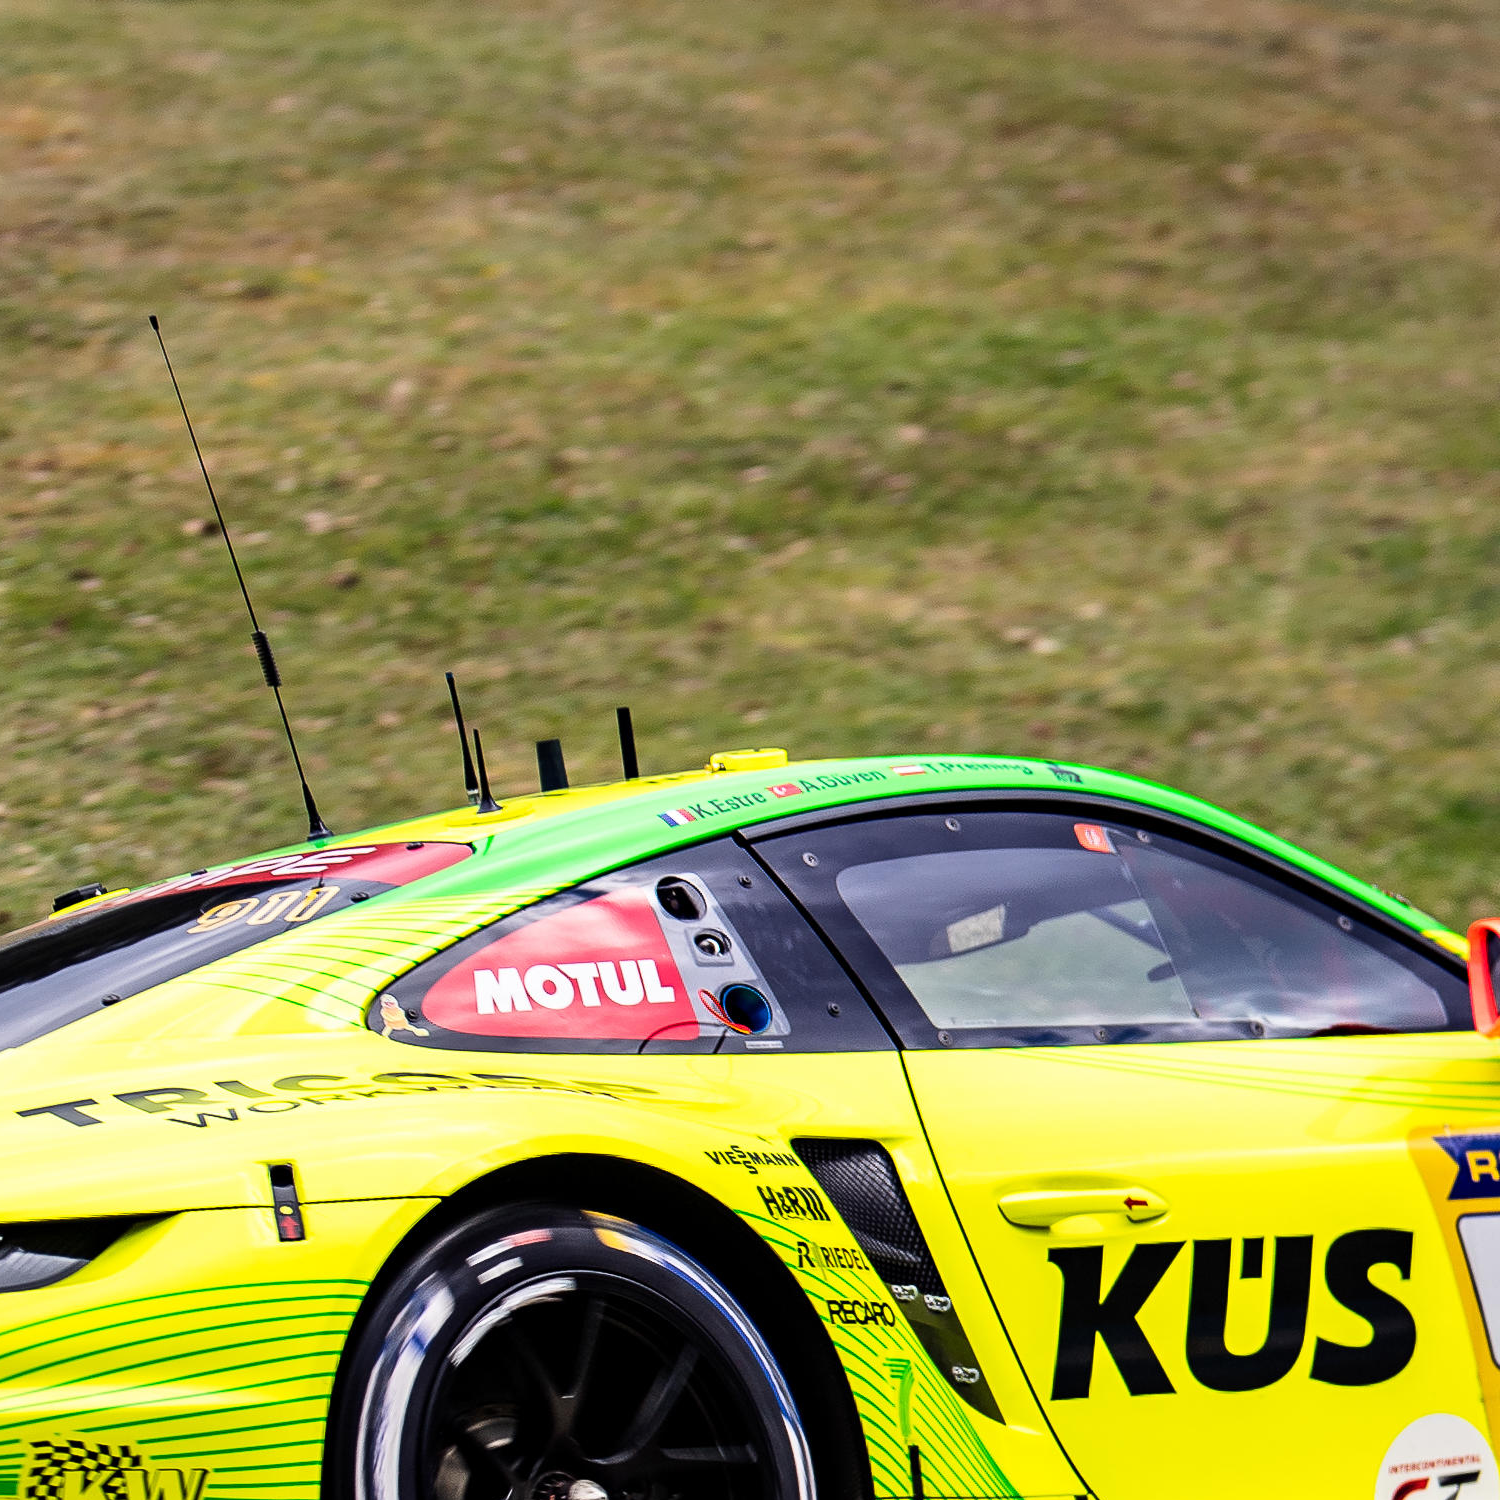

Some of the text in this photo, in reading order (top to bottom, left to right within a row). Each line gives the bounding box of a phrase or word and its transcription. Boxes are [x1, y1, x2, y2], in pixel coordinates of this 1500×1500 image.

[187, 885, 341, 934] 911
[473, 958, 676, 1015] MOTUL
[704, 1145, 800, 1175] VIESSMANN
[820, 1246, 870, 1272] RIEDEL
[827, 1299, 896, 1328] RECARO
[1047, 1228, 1417, 1401] KÜS
